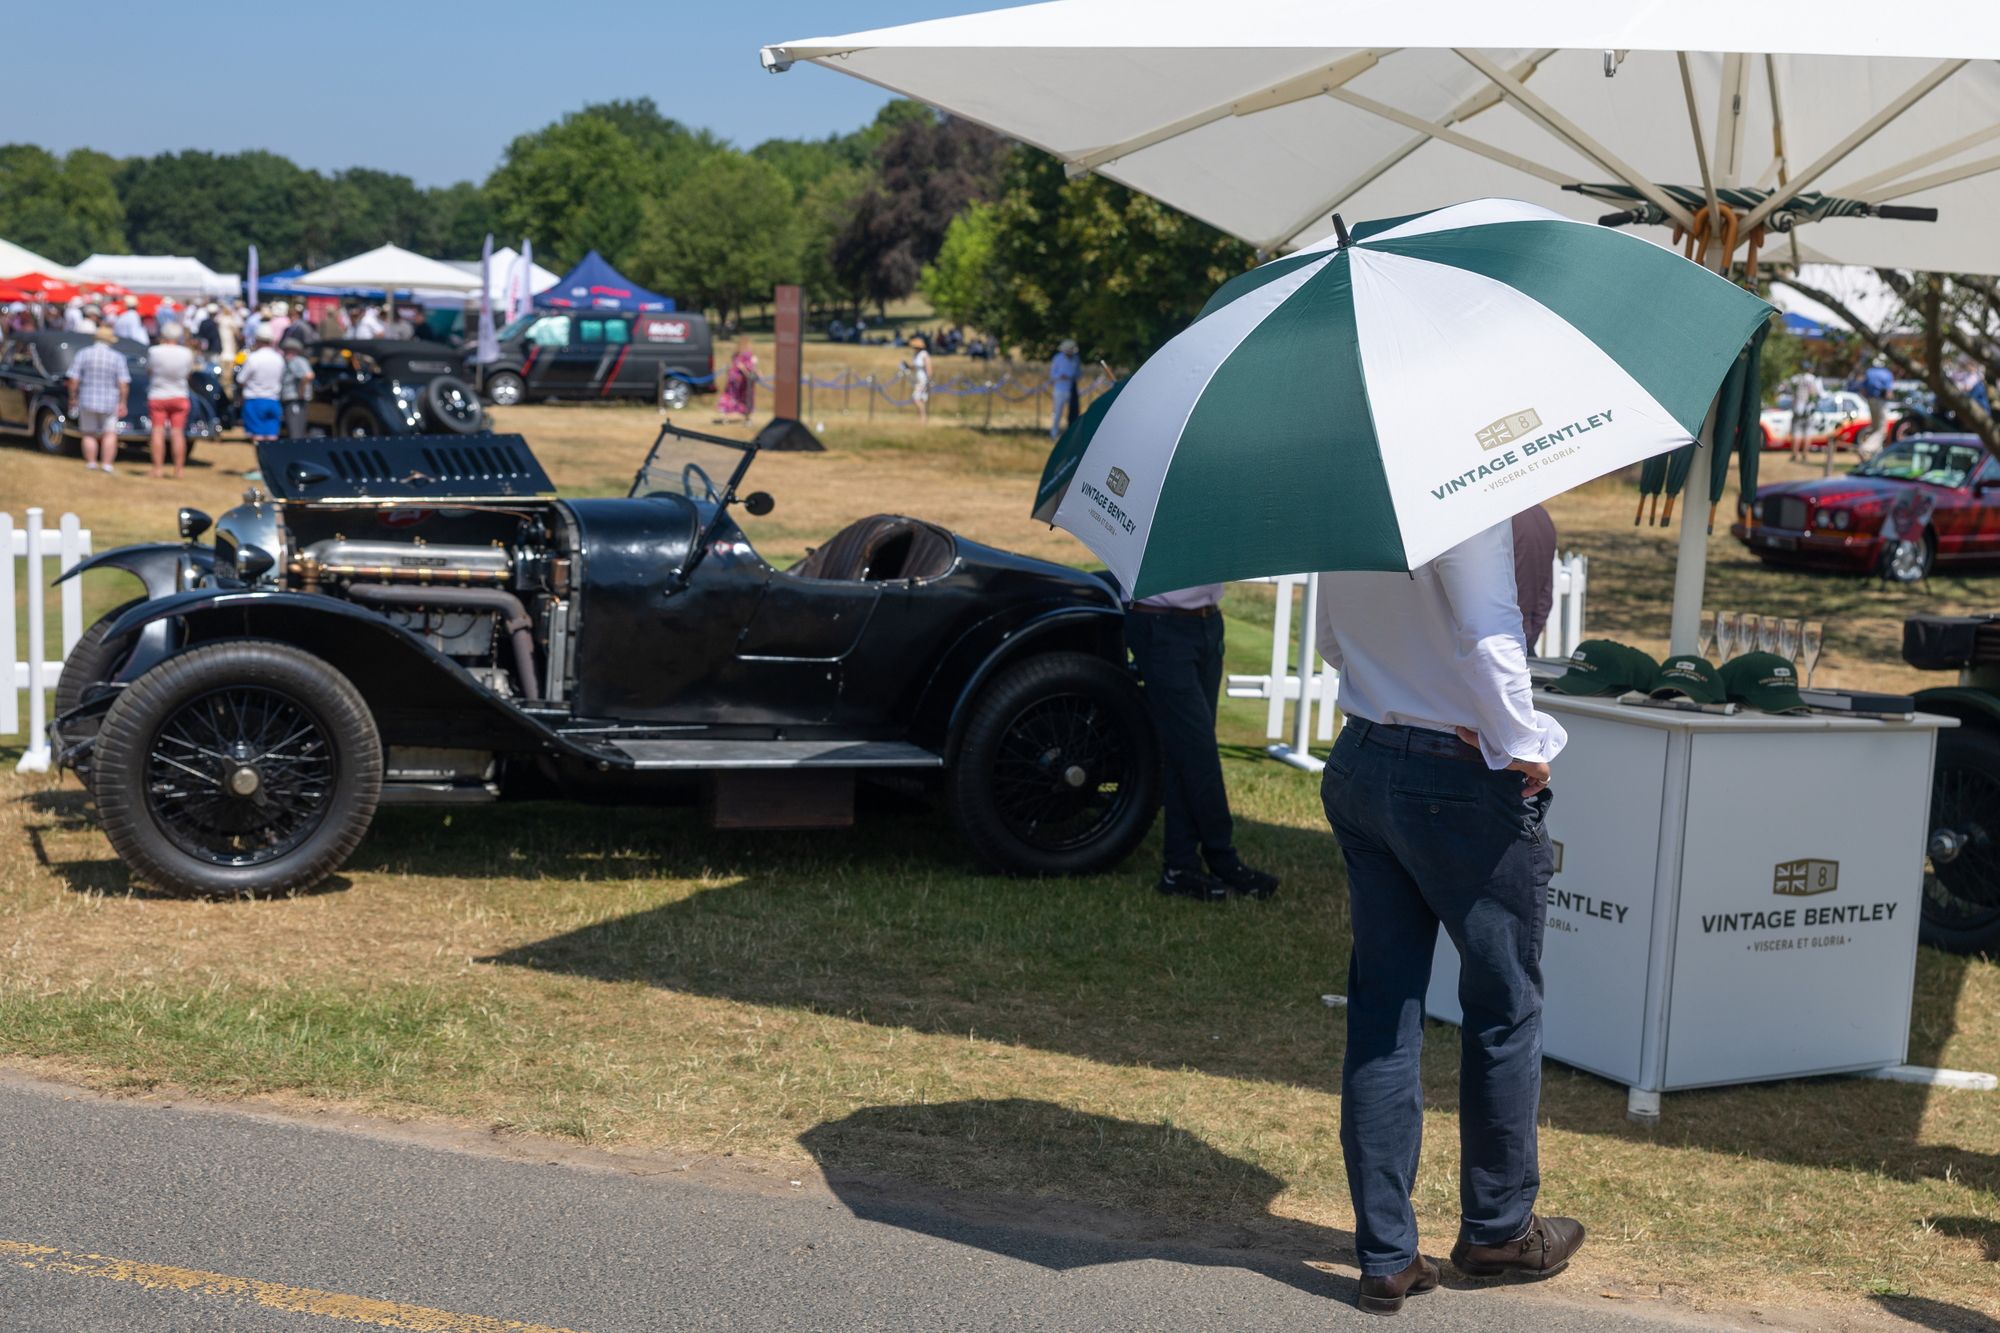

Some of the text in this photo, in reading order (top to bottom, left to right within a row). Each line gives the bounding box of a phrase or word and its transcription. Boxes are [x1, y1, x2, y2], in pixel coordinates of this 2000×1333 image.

[1518, 415, 1530, 429] 8
[1430, 409, 1614, 500] VINTAGE BENTLEY
[1488, 447, 1576, 491] VISCERA ET GLORIA
[1080, 480, 1109, 509] VINTAGE
[1107, 501, 1137, 535] BENTLEY
[1817, 866, 1828, 888] 8
[1547, 887, 1629, 924] ENTLEY
[1701, 902, 1898, 934] VINTAGE BENTLEY
[1545, 917, 1572, 933] ORIA
[1754, 935, 1846, 953] VISCERA ET GLORIA
